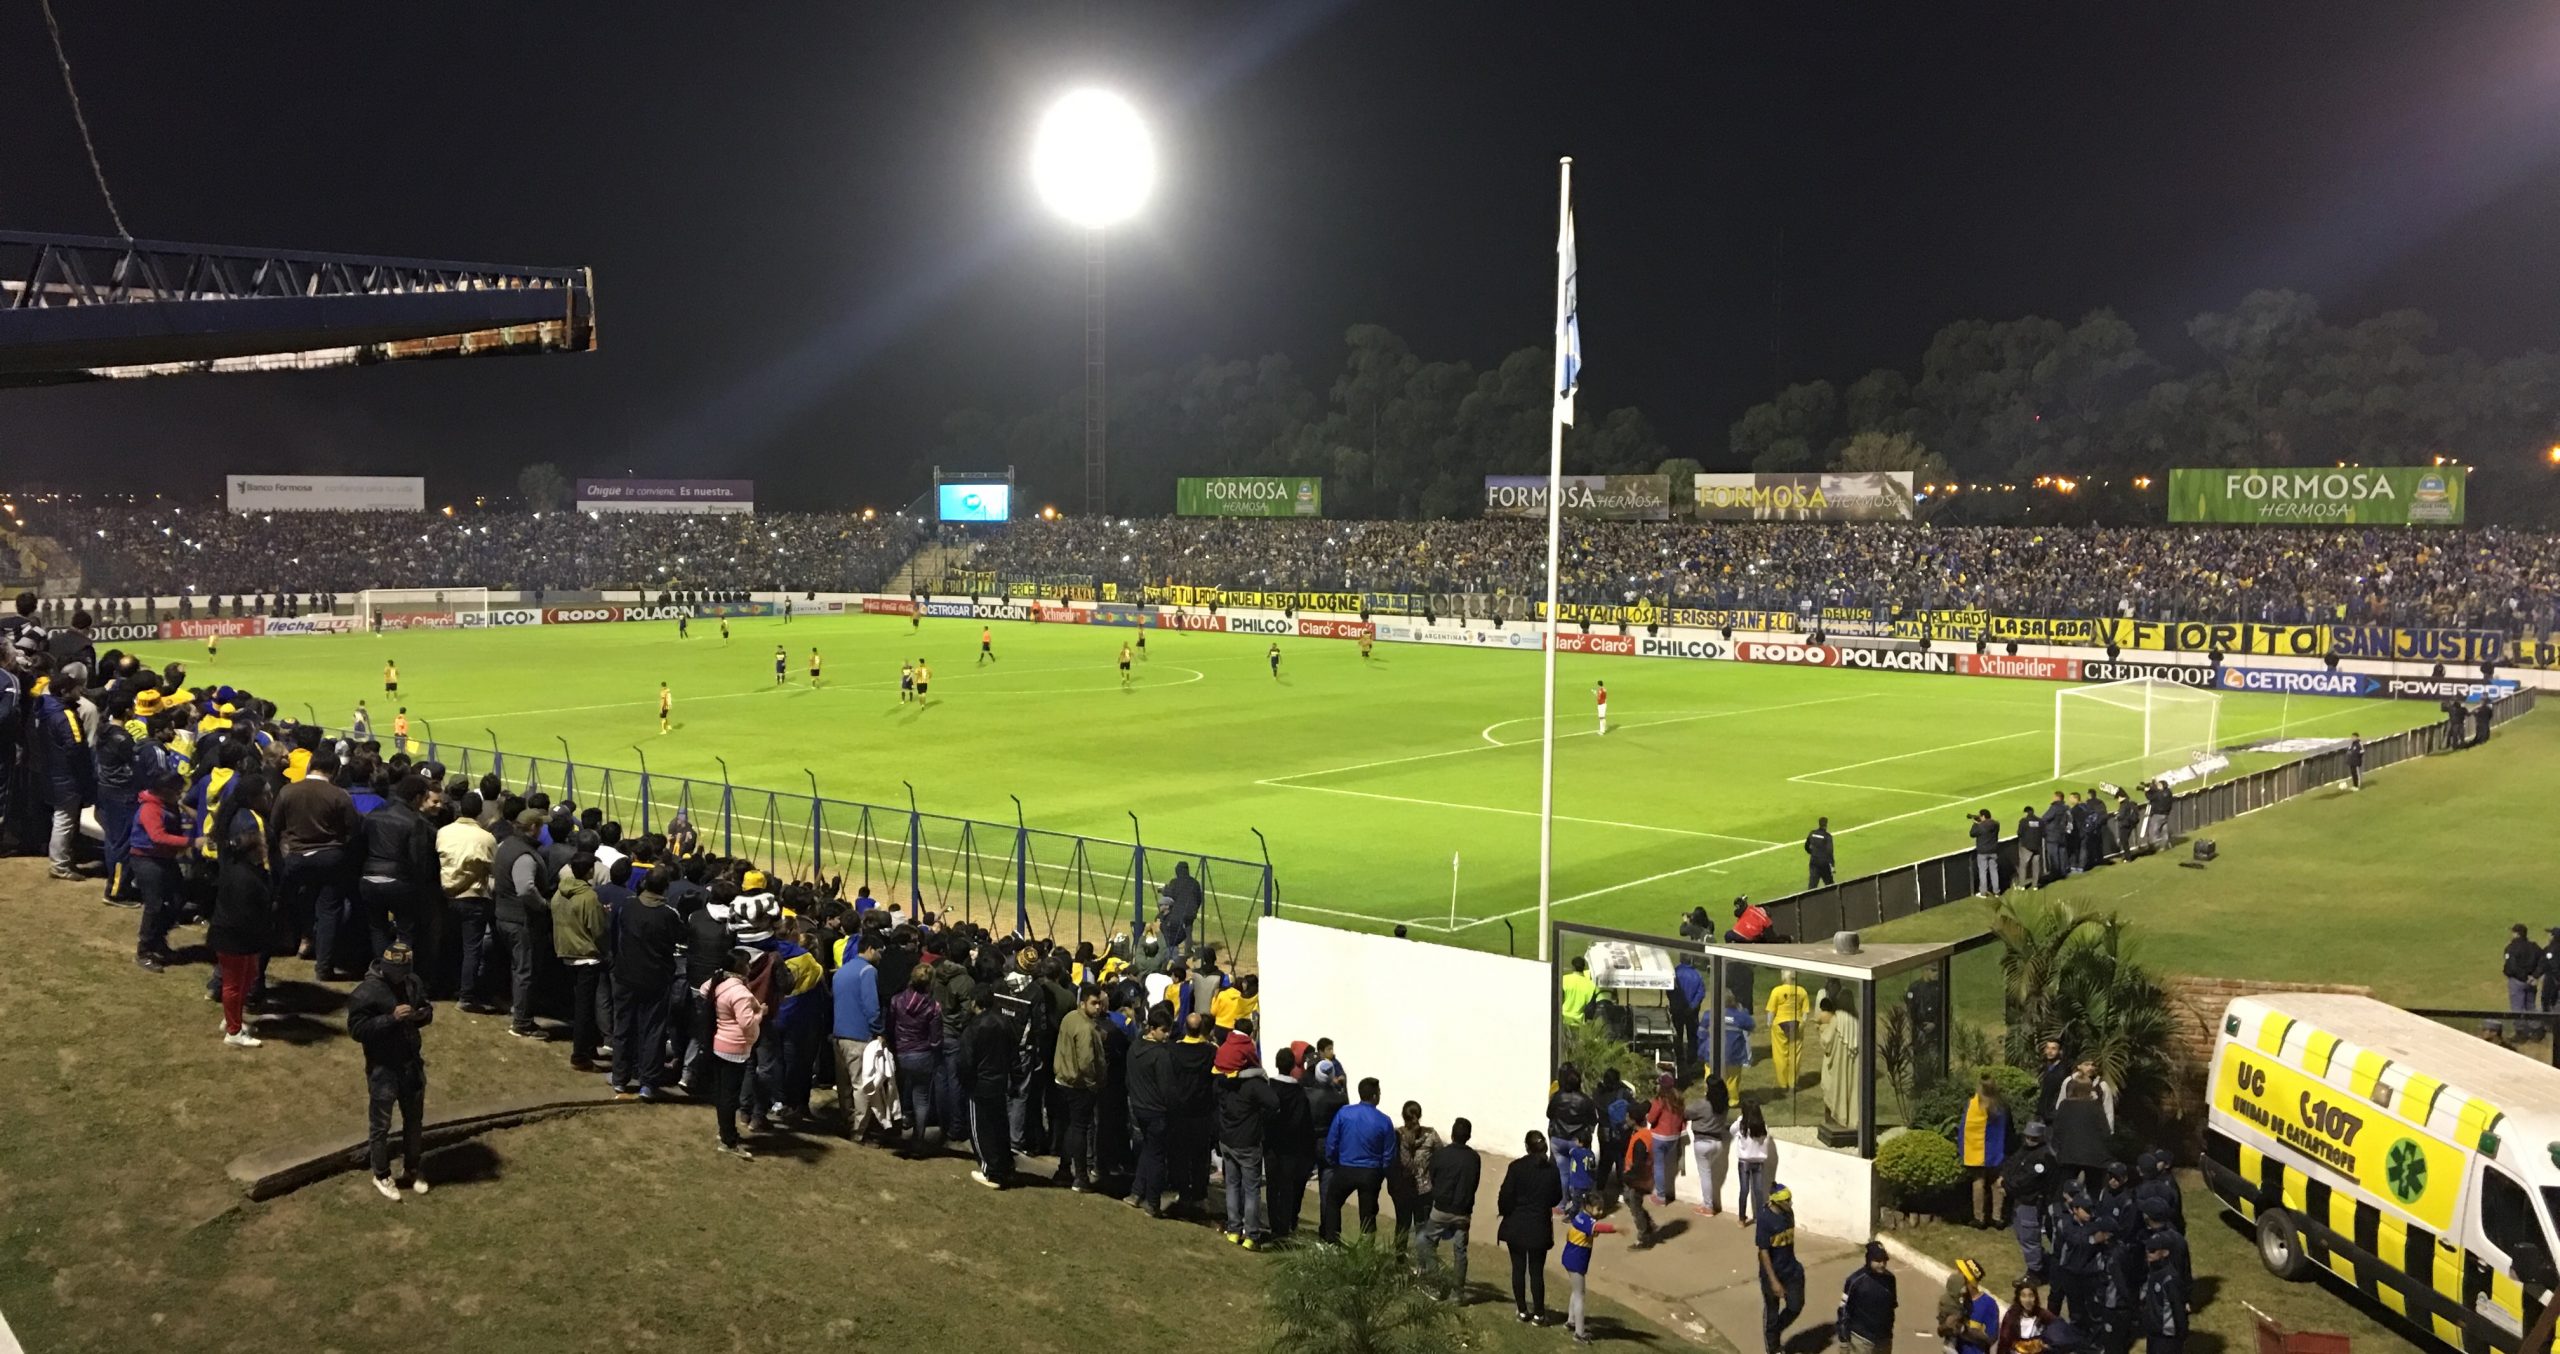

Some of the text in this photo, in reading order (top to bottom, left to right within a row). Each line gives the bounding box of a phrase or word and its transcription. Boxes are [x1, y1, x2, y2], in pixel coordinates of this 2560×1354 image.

[247, 483, 313, 492] Banco Formosa
[625, 486, 634, 496] te
[679, 486, 691, 496] Es
[693, 487, 735, 497] nuestra.
[1205, 482, 1289, 500] FORMOSA
[2226, 474, 2396, 500] FORMOSA
[1598, 494, 1663, 509] HERMOSA
[1700, 485, 1829, 508] FORMOSA
[1829, 493, 1905, 508] HERMOSA
[1222, 501, 1267, 513] HERMOSA
[2258, 503, 2352, 518] HERMOSA
[926, 603, 971, 617] CETROGAR
[1276, 593, 1360, 611] BOULOGNE
[411, 615, 451, 626] Claro
[462, 611, 529, 625] PHILCO
[557, 609, 610, 622] RODO
[972, 604, 1028, 620] POLACRIN
[1042, 608, 1081, 623] Schneider
[1559, 604, 1605, 622] PLATA
[1660, 608, 1728, 626] BERISSO
[180, 618, 245, 638] Schneider
[1231, 617, 1287, 635] PHILCO
[1299, 621, 1332, 636] Claro
[1896, 621, 1989, 641] MARTINEZ
[1546, 635, 1629, 654] laro Claro
[1642, 639, 1718, 659] PHILCO
[1749, 643, 1826, 663] RODO
[2332, 625, 2502, 663] SAN JUSTO
[1841, 648, 1950, 673] POLACRIN
[1979, 655, 2056, 678] Schneider
[2084, 662, 2216, 686] CREDICOOP
[2246, 671, 2357, 693] CETROGAR
[2237, 1060, 2267, 1098] UC
[2311, 1099, 2364, 1147] 107
[2232, 1093, 2357, 1174] UNIDAD DE CATASTROFE
